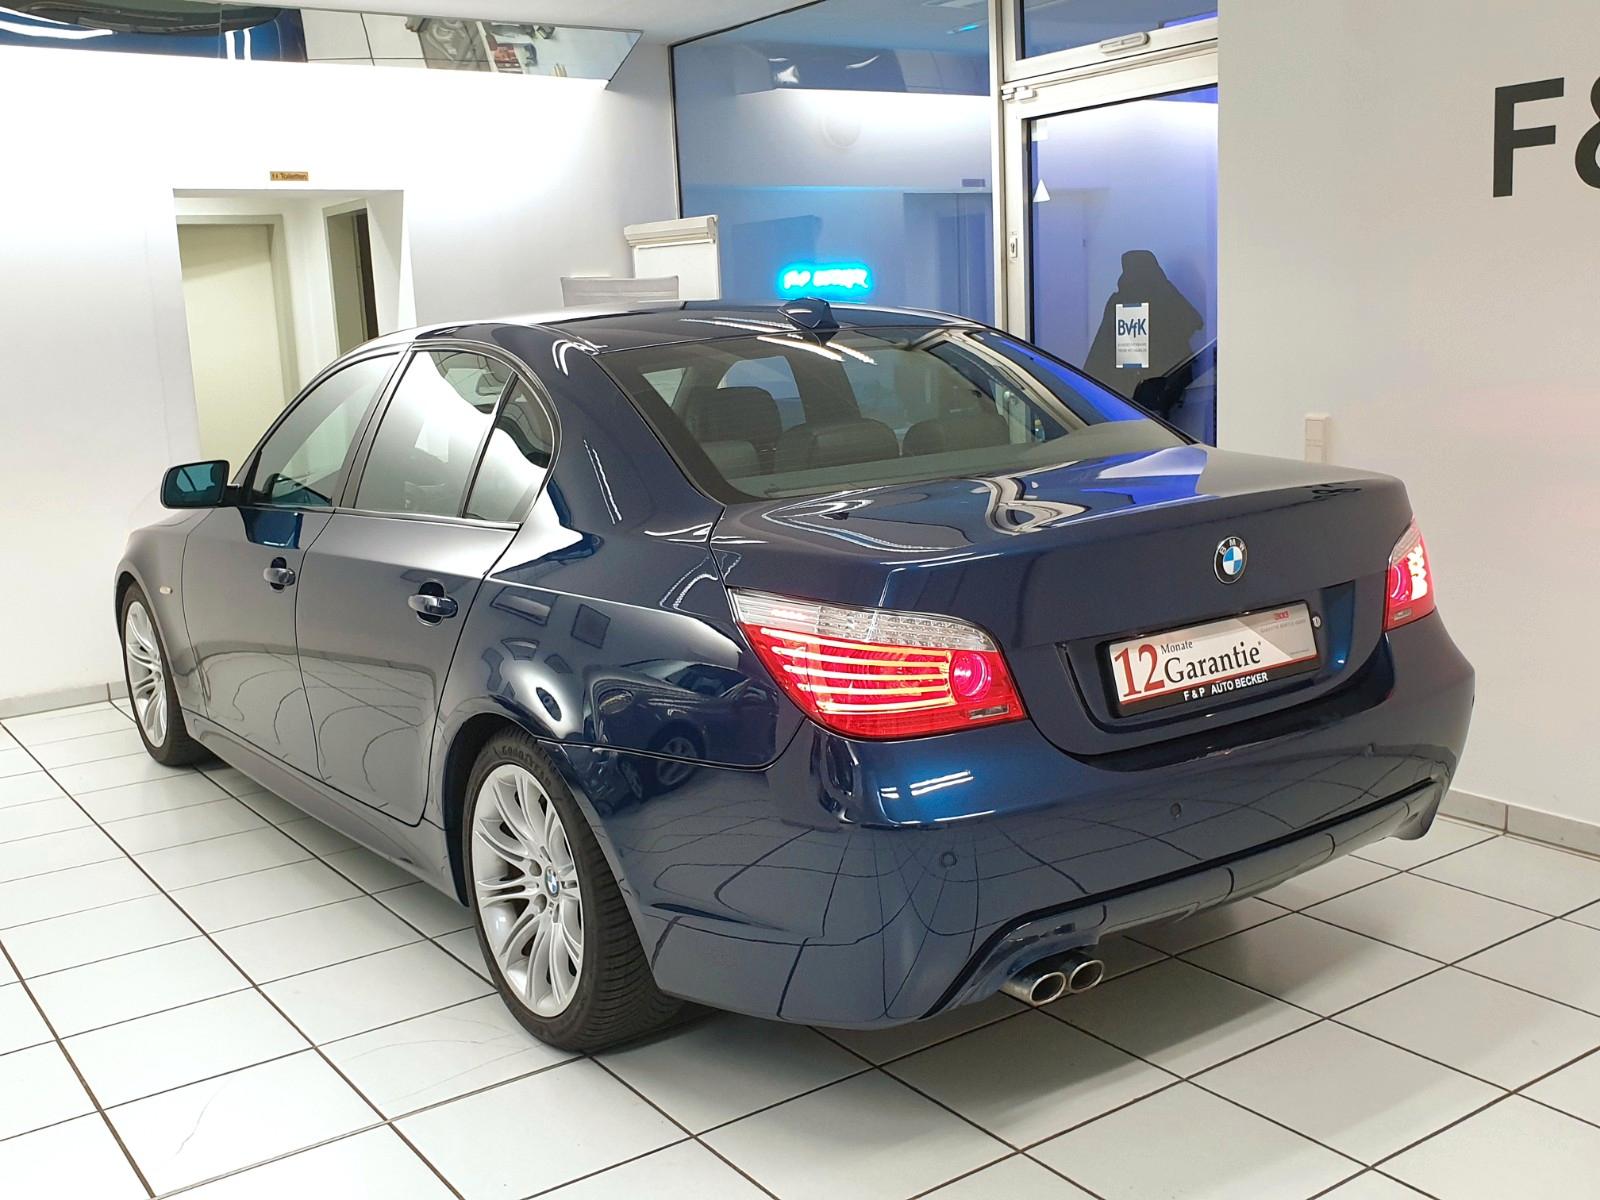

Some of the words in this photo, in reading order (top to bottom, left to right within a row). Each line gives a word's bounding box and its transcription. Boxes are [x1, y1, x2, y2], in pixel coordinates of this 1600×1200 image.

[1117, 318, 1147, 338] BVfK
[1160, 640, 1193, 655] Monate
[1114, 643, 1166, 698] 12
[1211, 680, 1234, 695] AUTO
[1235, 672, 1269, 689] BECKER
